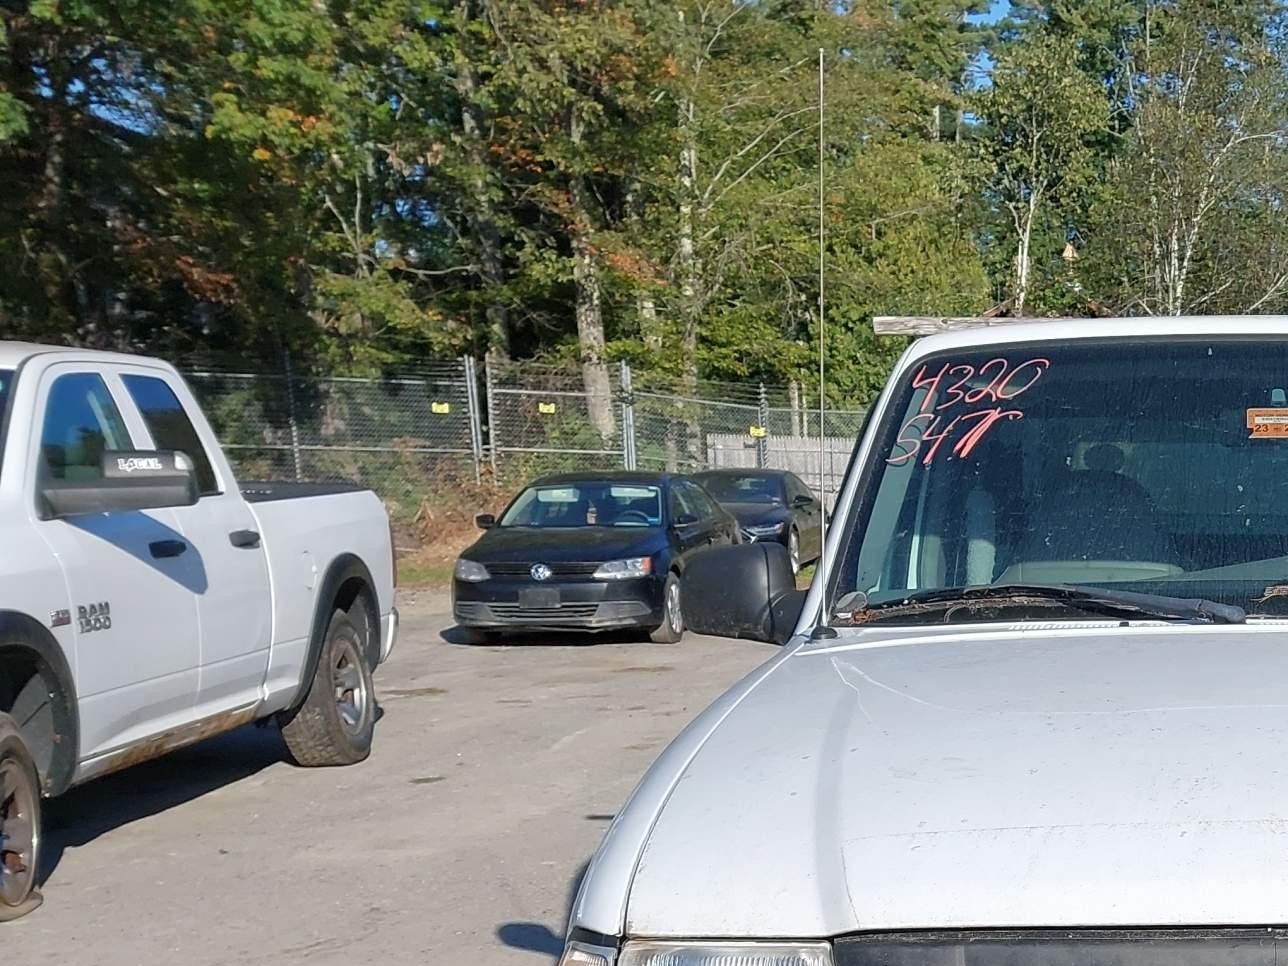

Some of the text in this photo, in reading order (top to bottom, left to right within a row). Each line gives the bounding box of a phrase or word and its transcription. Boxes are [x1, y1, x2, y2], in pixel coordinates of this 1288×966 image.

[912, 357, 1050, 412] 4320
[1255, 424, 1269, 432] 23
[77, 601, 111, 619] RAM
[79, 615, 112, 634] 1500
